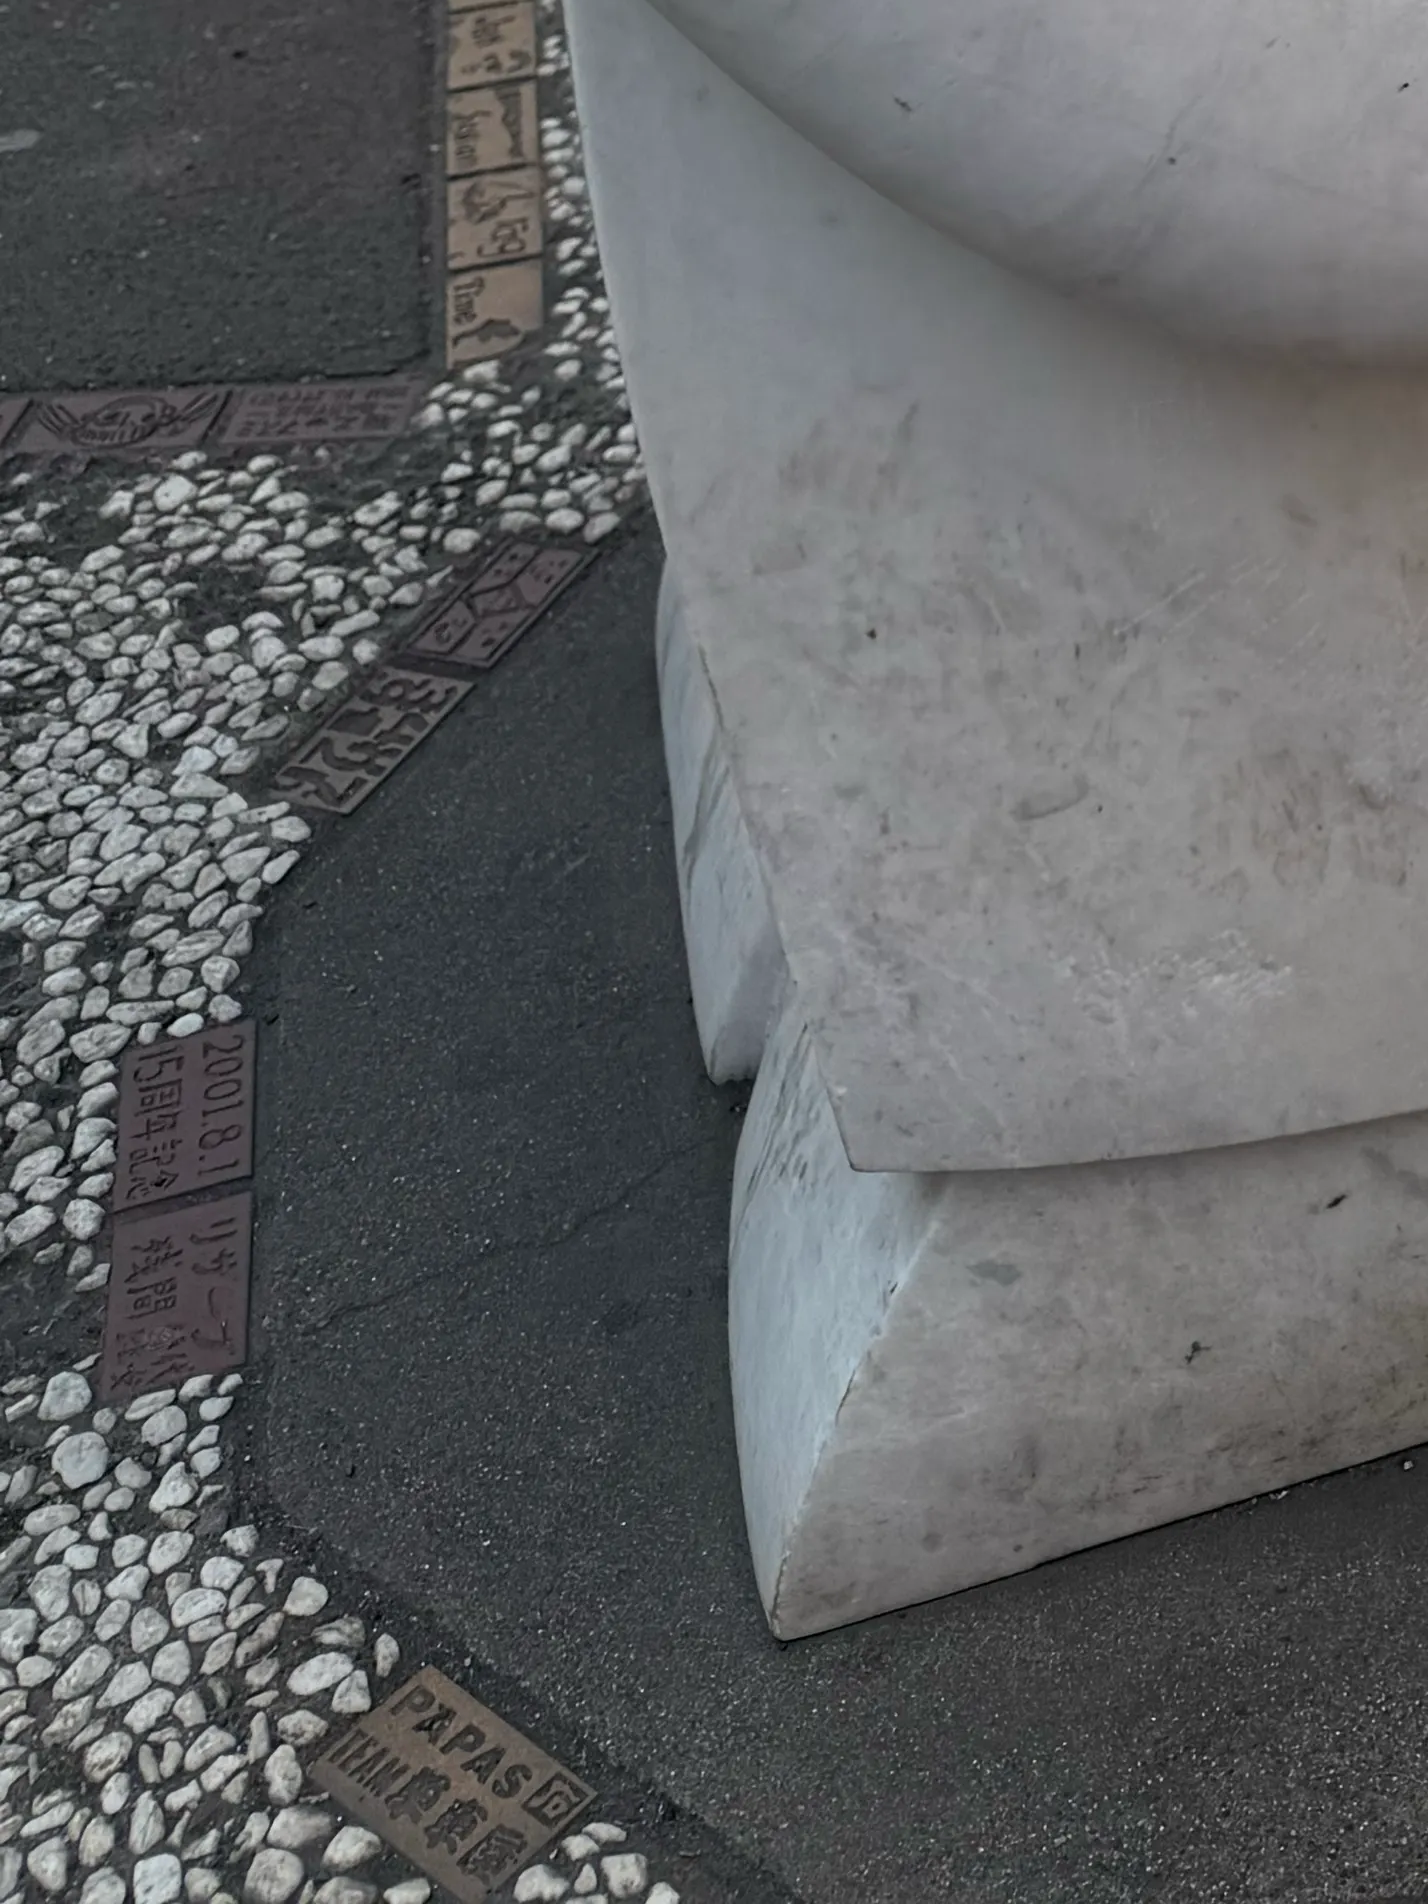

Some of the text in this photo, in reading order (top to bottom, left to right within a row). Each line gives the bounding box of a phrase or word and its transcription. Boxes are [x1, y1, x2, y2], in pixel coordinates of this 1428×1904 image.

[125, 1046, 186, 1202] 15周年記念
[198, 1034, 245, 1177] 2001.8.1
[327, 1727, 412, 1799] TEAM
[391, 1684, 534, 1800] PAPAS
